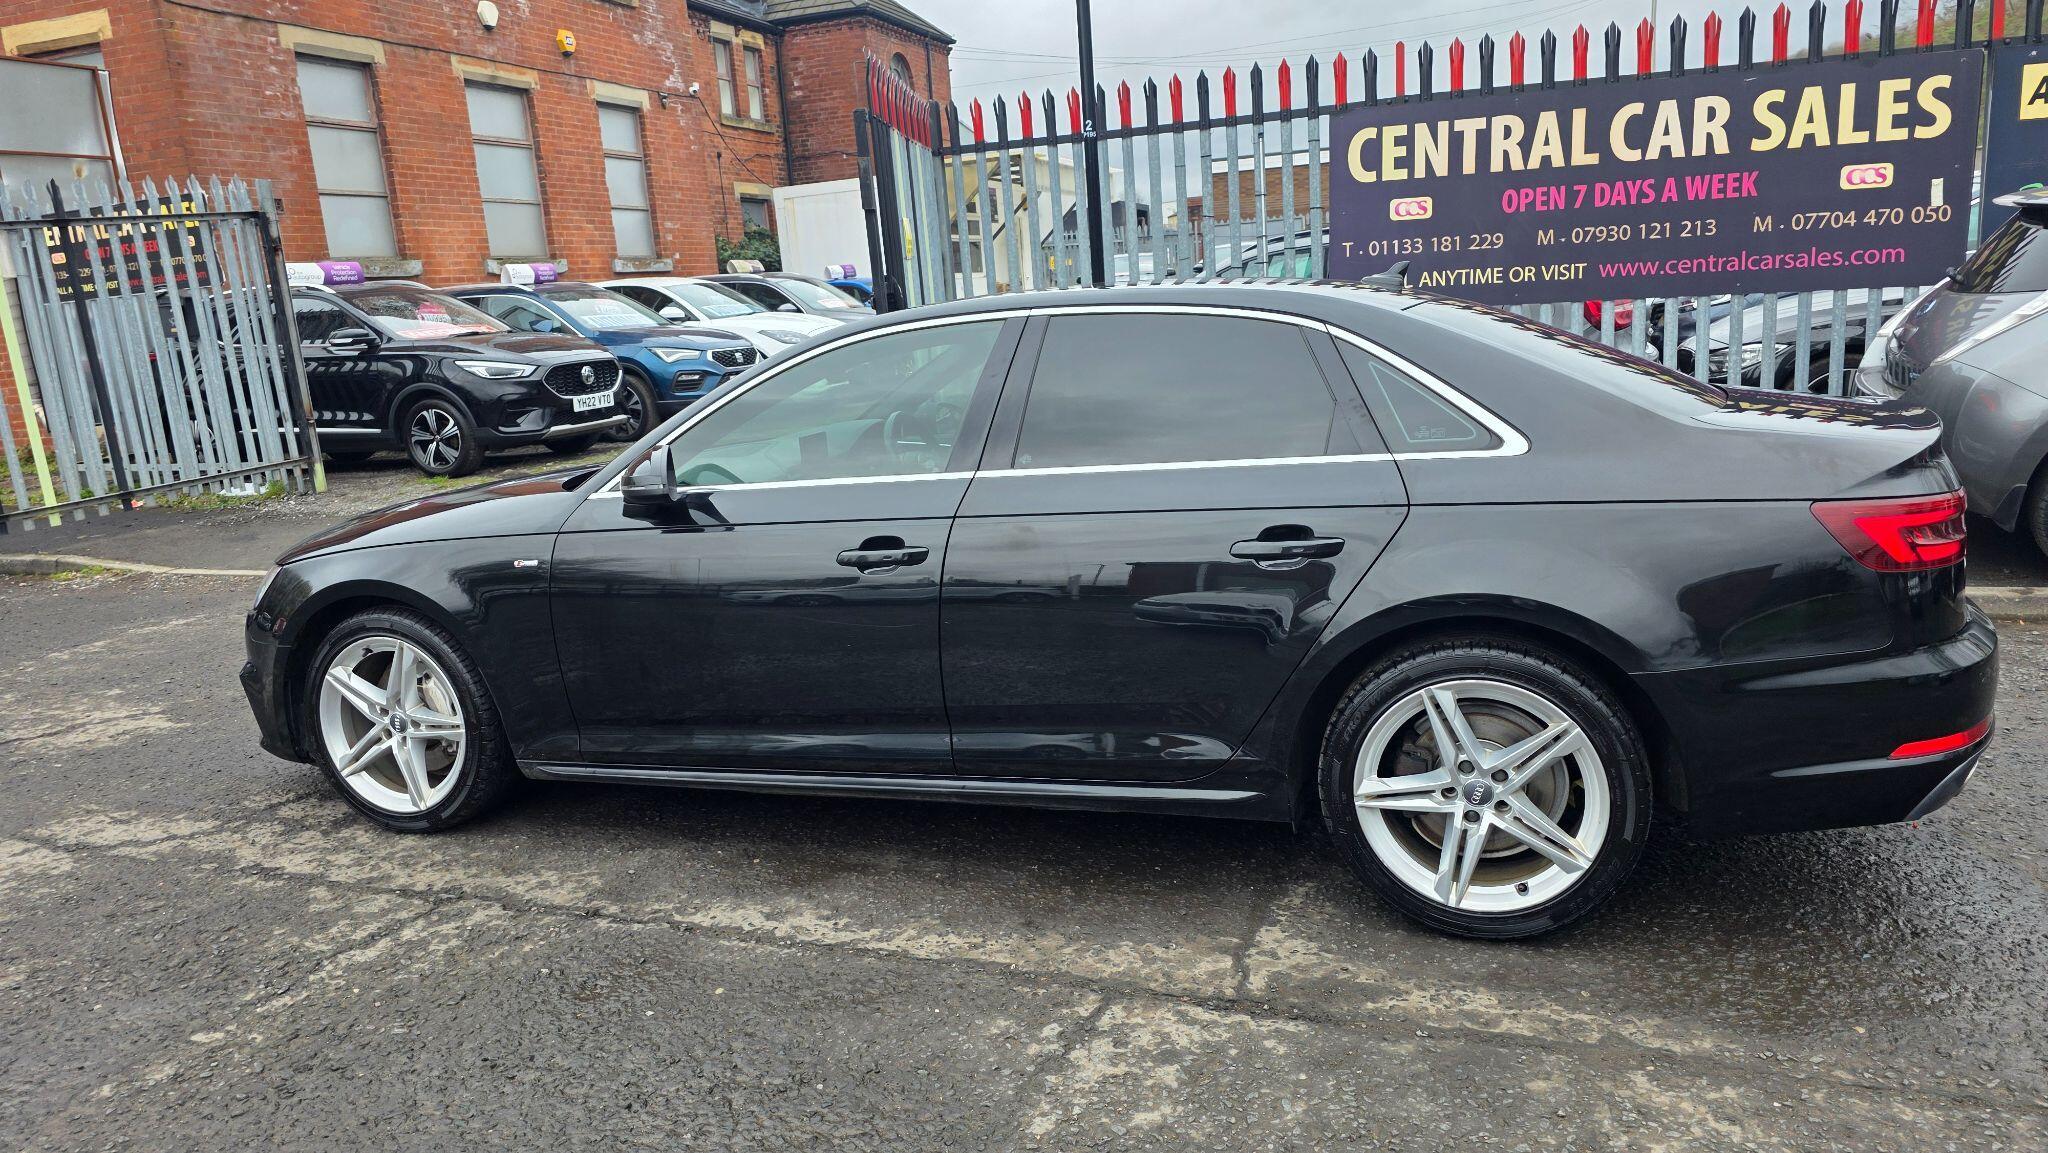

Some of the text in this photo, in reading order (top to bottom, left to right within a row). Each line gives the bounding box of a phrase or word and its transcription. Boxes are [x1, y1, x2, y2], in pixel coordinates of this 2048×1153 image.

[1085, 119, 1093, 131] 2
[1348, 74, 1954, 184] CENTRAL CAR SALES
[1501, 171, 1759, 214] OPEN 7 DAYS A WEEK
[1791, 211, 1858, 231] 07704
[1863, 208, 1905, 226] 470
[1910, 204, 1952, 224] 050
[1368, 238, 1424, 256] 01133
[1431, 235, 1461, 253] 181
[1467, 233, 1504, 250] 229
[1571, 225, 1631, 244] 07930
[1638, 222, 1671, 240] 121
[1680, 219, 1717, 238] 213
[1417, 267, 1504, 288] ANYTIME
[1508, 265, 1536, 283] OR
[1541, 262, 1588, 281] VISIT
[1599, 248, 1904, 278] www.centralcarsales.com
[577, 393, 611, 409] YH22 VTO
